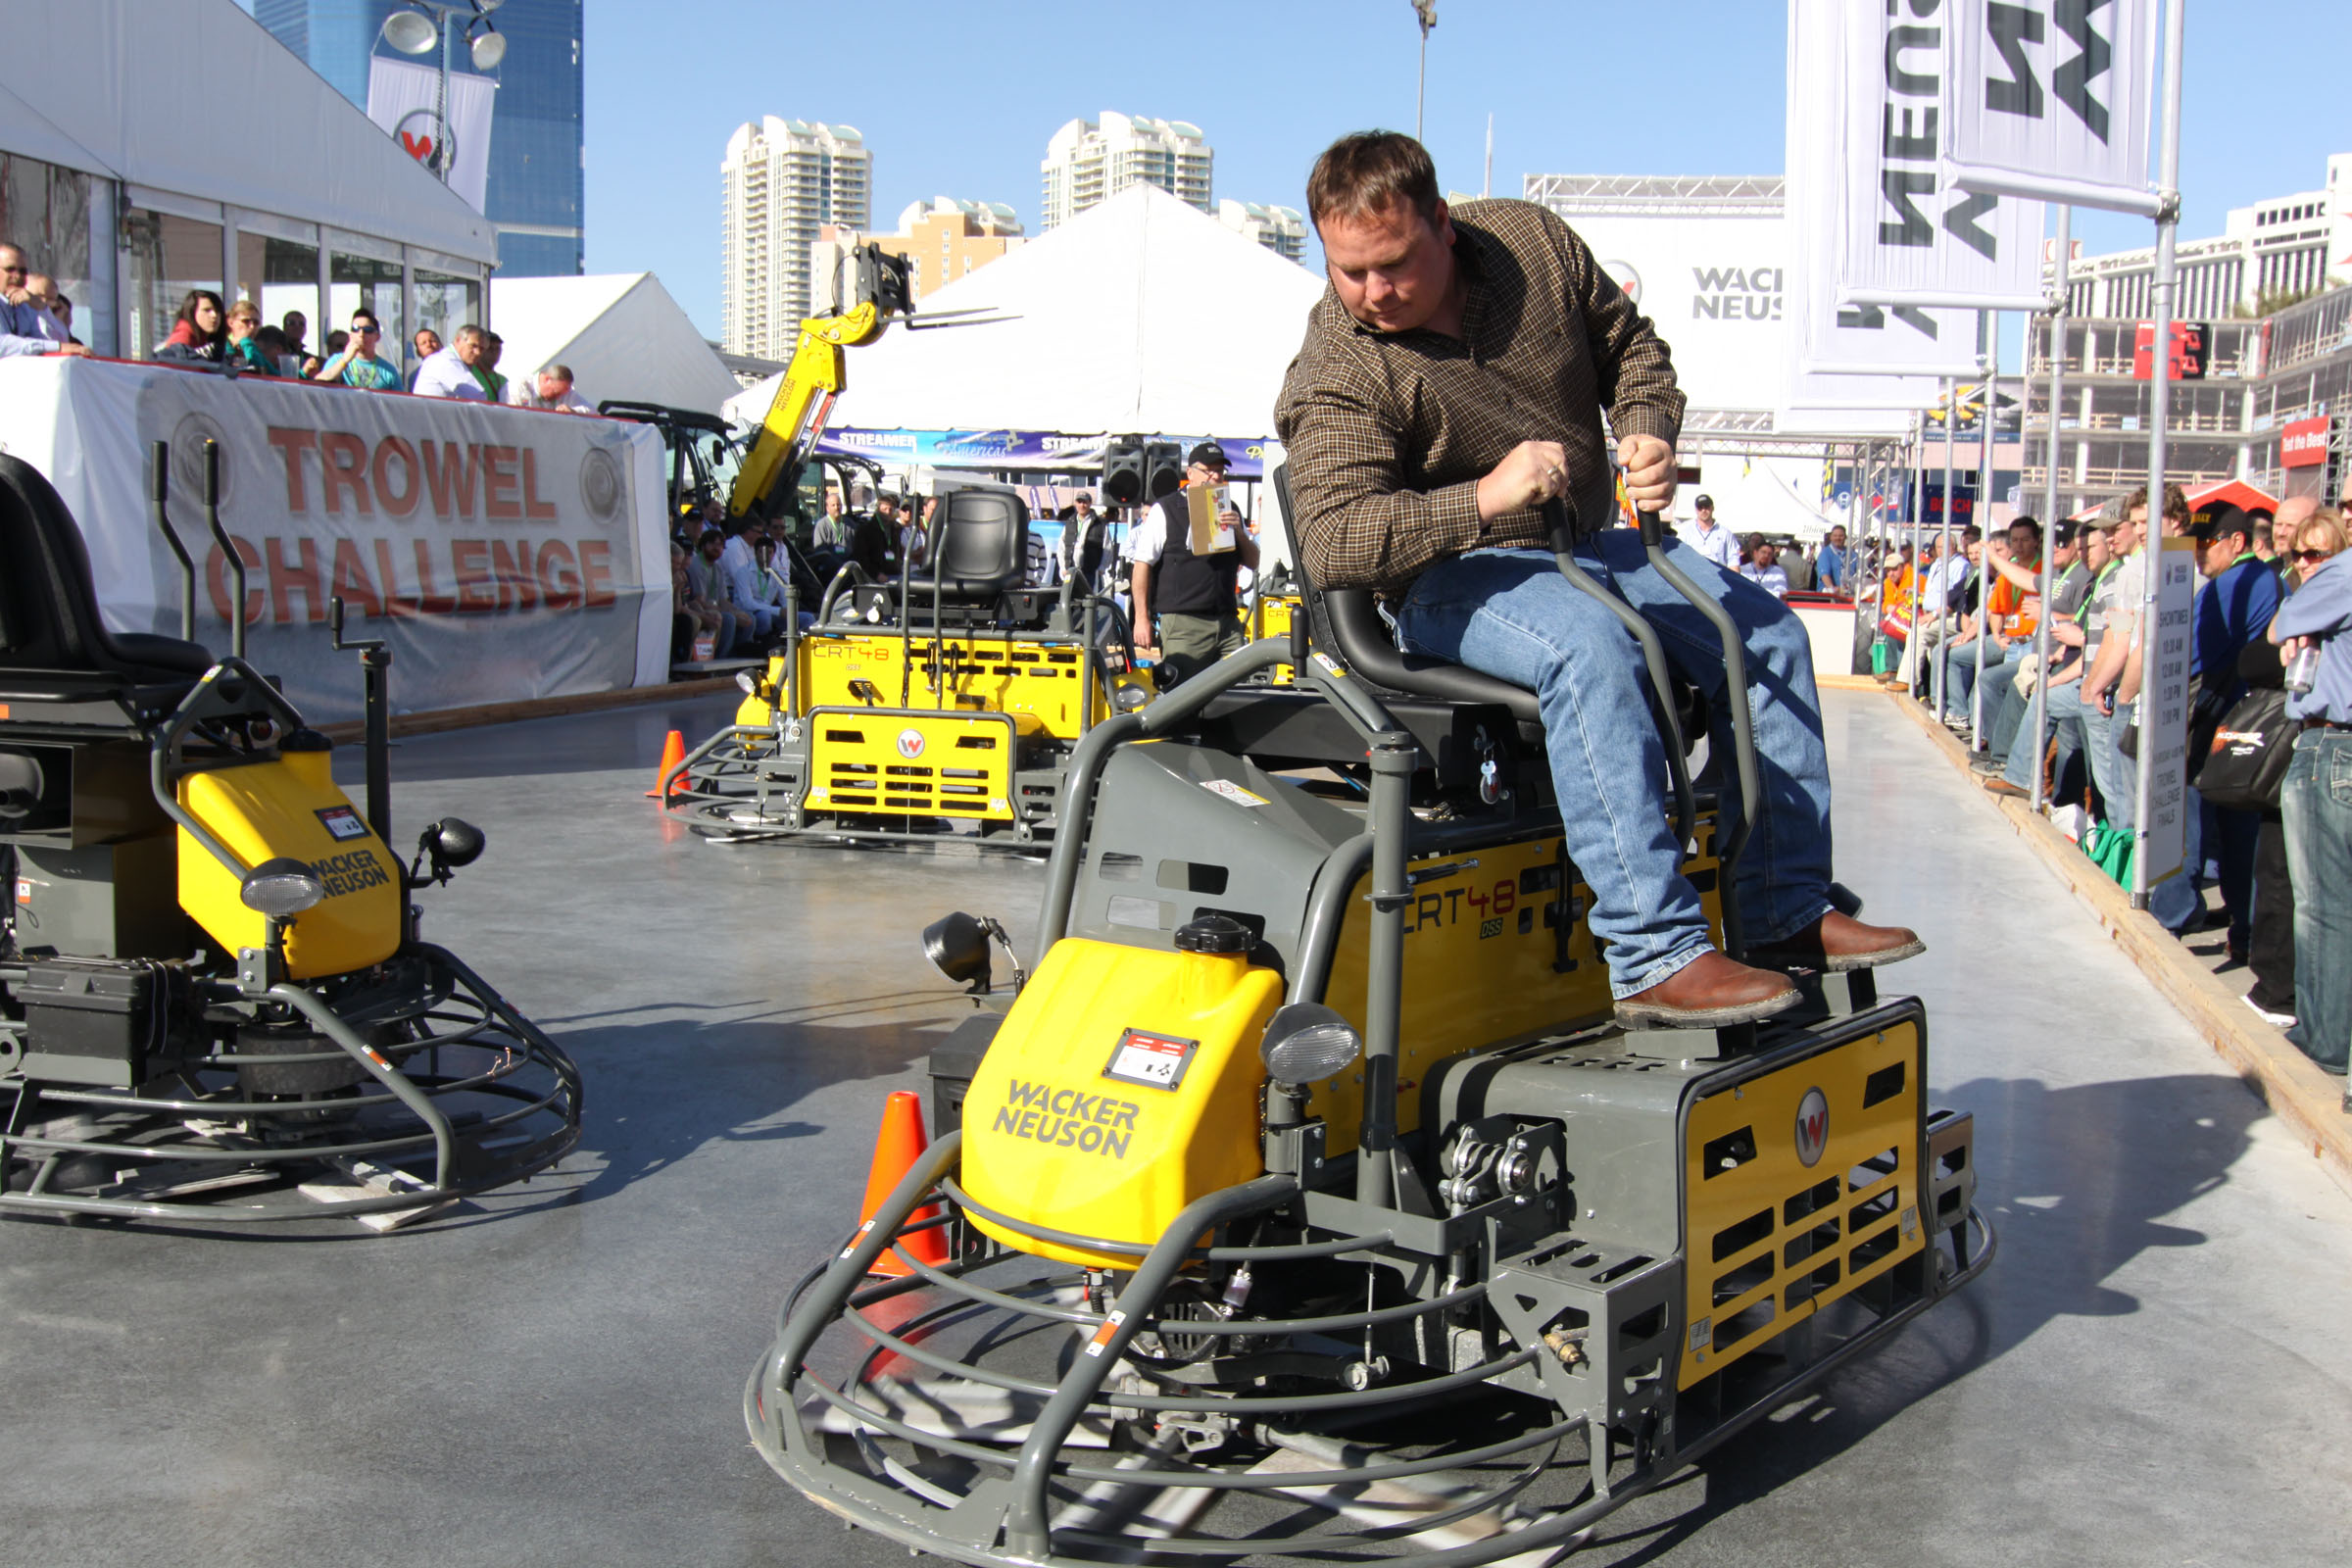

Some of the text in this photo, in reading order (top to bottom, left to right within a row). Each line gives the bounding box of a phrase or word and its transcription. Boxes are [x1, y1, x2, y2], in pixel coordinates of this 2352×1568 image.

[780, 379, 797, 412] NEUSON
[2281, 430, 2327, 453] Test the Best
[267, 425, 558, 521] TROWEL
[1929, 497, 1972, 514] BOSCH
[204, 535, 616, 626] CHALLENGE
[310, 849, 380, 878] WACKER
[321, 865, 391, 900] NEUSON
[1481, 919, 1503, 938] DSS
[1007, 1078, 1142, 1131] WACKER
[992, 1105, 1133, 1160] NEUSON
